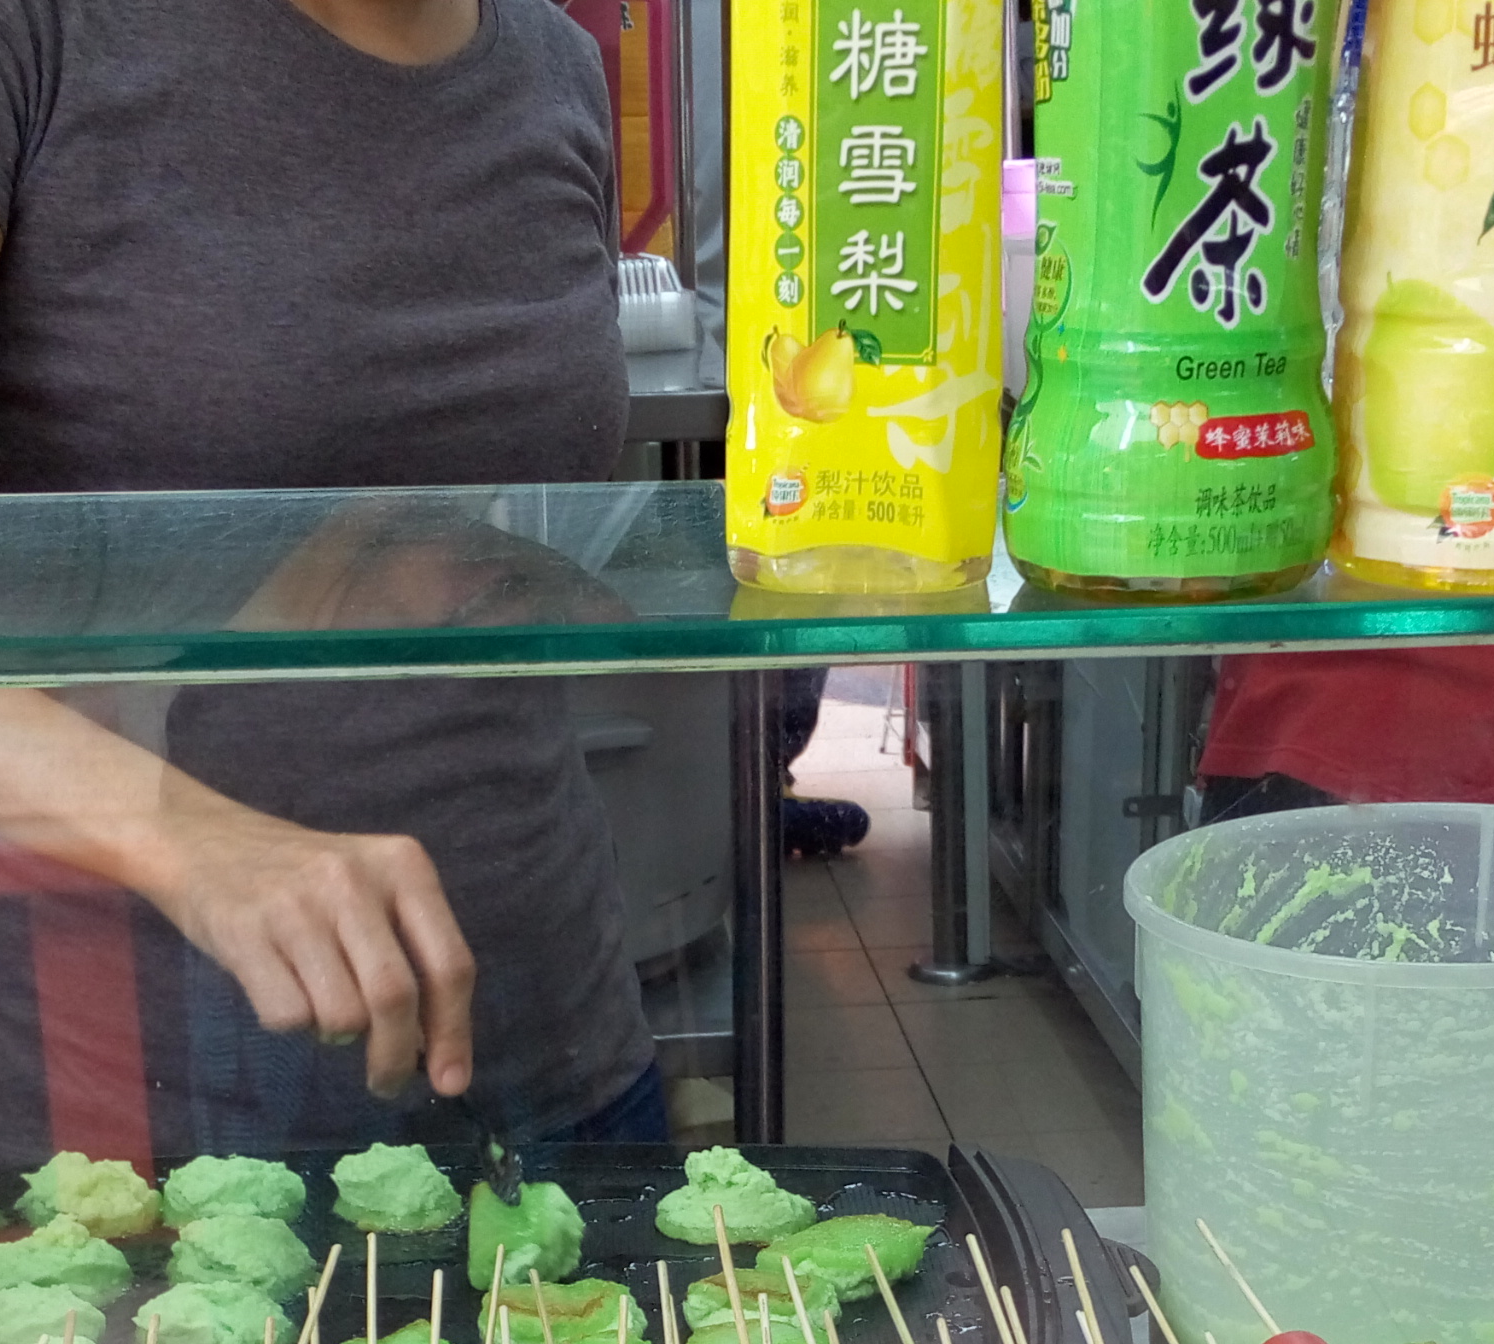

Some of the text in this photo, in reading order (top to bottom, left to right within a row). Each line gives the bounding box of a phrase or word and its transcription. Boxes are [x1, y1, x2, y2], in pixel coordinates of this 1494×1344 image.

[829, 8, 928, 316] 糖雪梨
[776, 117, 802, 302] 清润每一刻
[1176, 352, 1287, 381] Green Tea
[1205, 418, 1311, 452] 蜂蜜茉莉味
[815, 469, 924, 500] 梨汁饮品
[1195, 484, 1277, 519] 调味茶饮品
